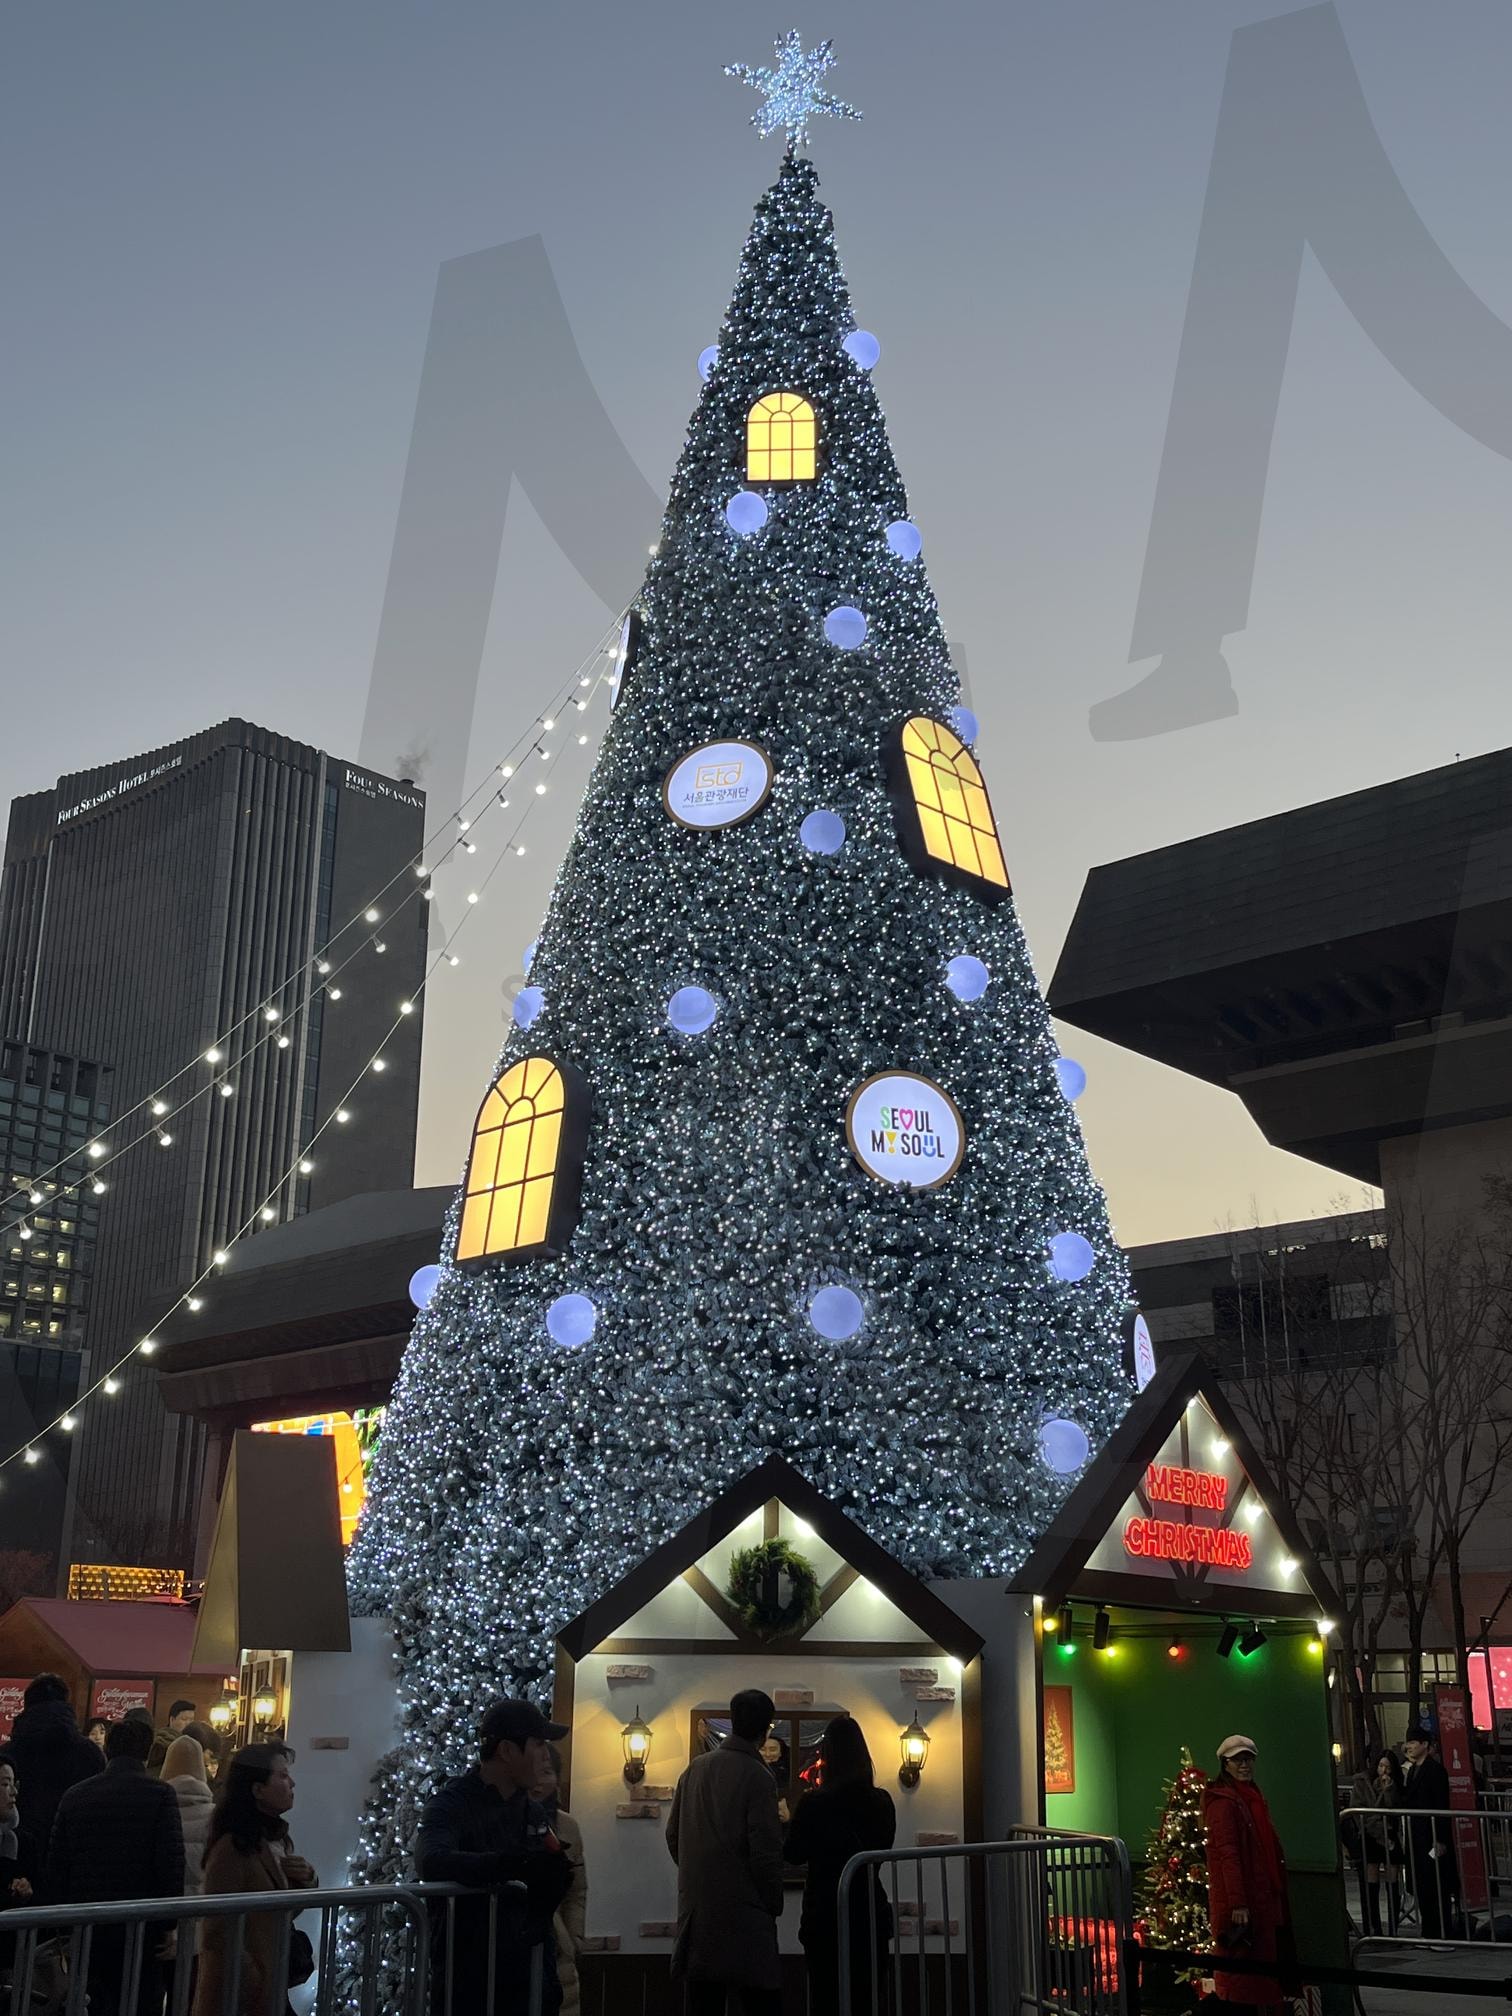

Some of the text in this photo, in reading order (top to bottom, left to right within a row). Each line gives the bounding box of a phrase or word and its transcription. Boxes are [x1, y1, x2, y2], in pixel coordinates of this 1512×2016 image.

[57, 772, 148, 825] FOUR SEASONS HOTEL
[377, 782, 424, 808] SEASONS
[683, 787, 750, 804] 서울관광재단
[901, 1133, 945, 1158] SOUL
[1146, 1464, 1227, 1510] MERRY
[1124, 1517, 1252, 1568] CHRISTMAS
